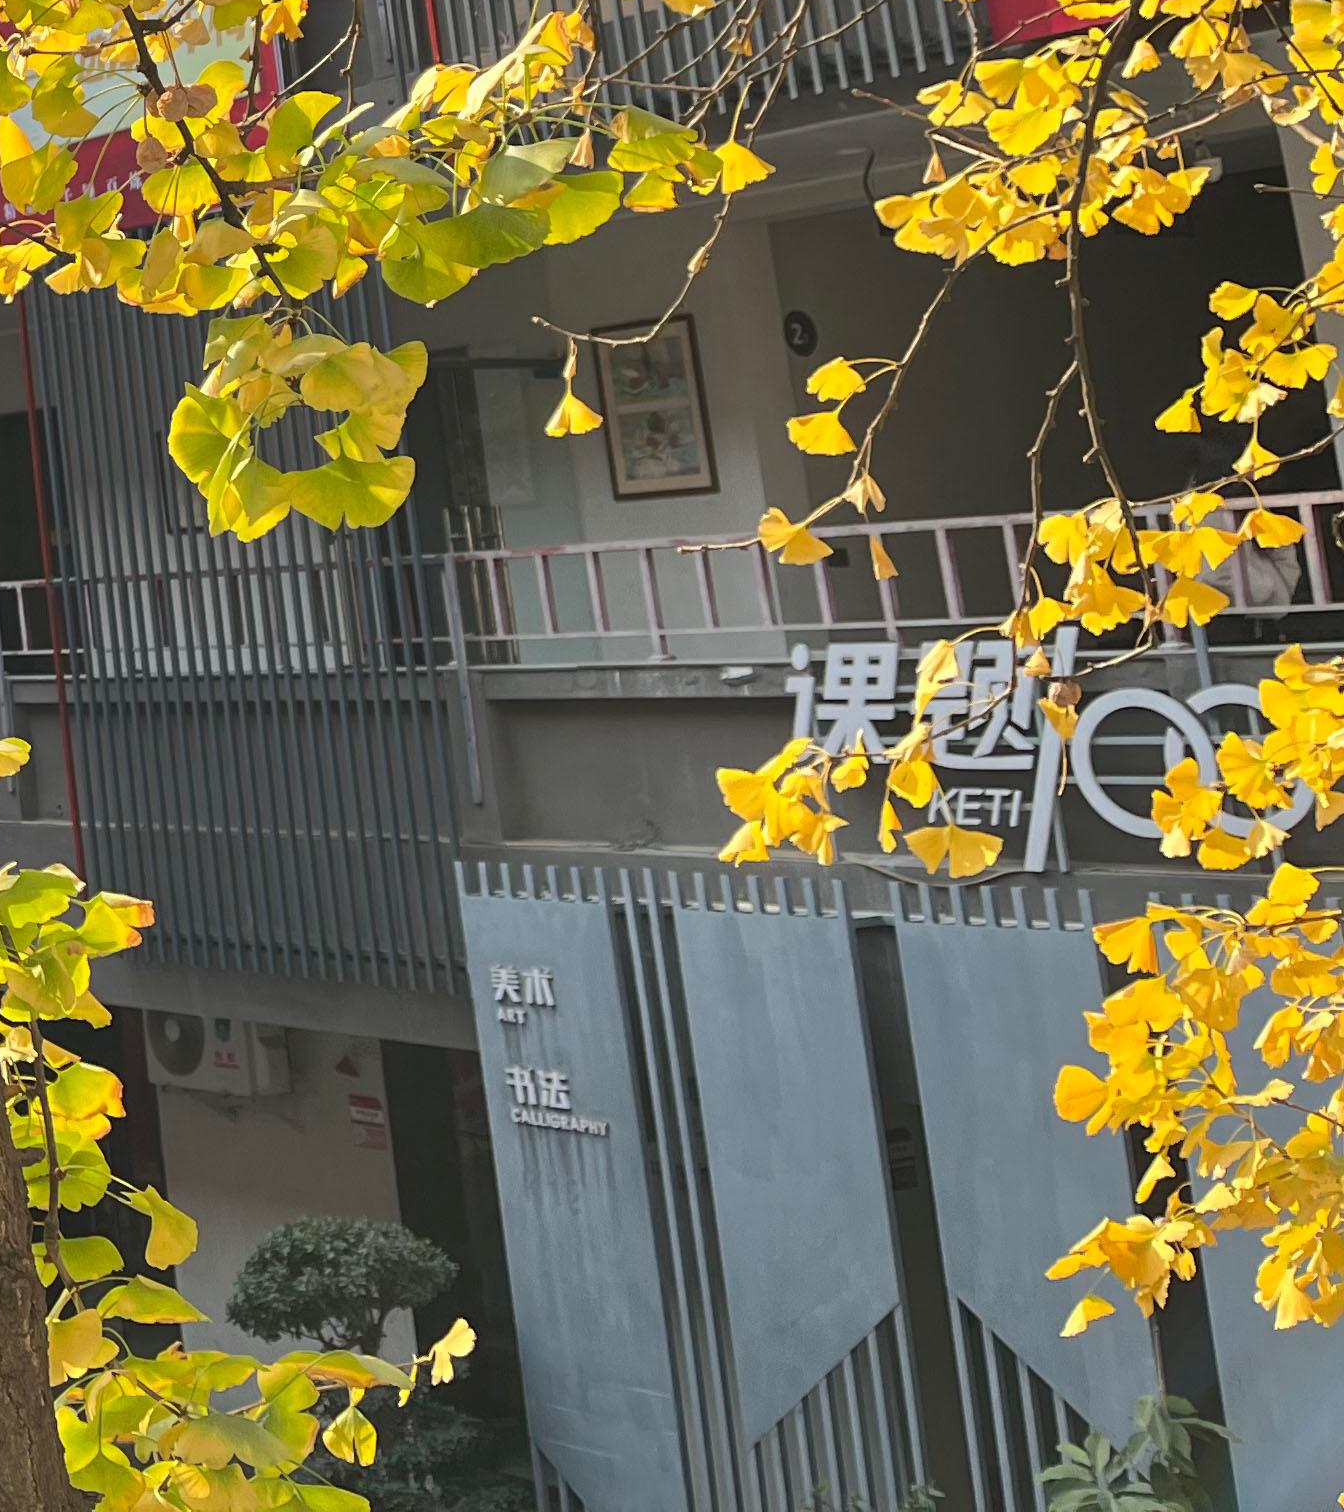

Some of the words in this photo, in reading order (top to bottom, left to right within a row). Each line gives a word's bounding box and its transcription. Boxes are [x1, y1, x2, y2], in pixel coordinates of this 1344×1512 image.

[927, 787, 1023, 828] KETI
[490, 964, 557, 1007] 美术
[497, 1007, 527, 1025] ART
[505, 1066, 571, 1110] 书法
[512, 1108, 610, 1137] CALLIGRAPHY
